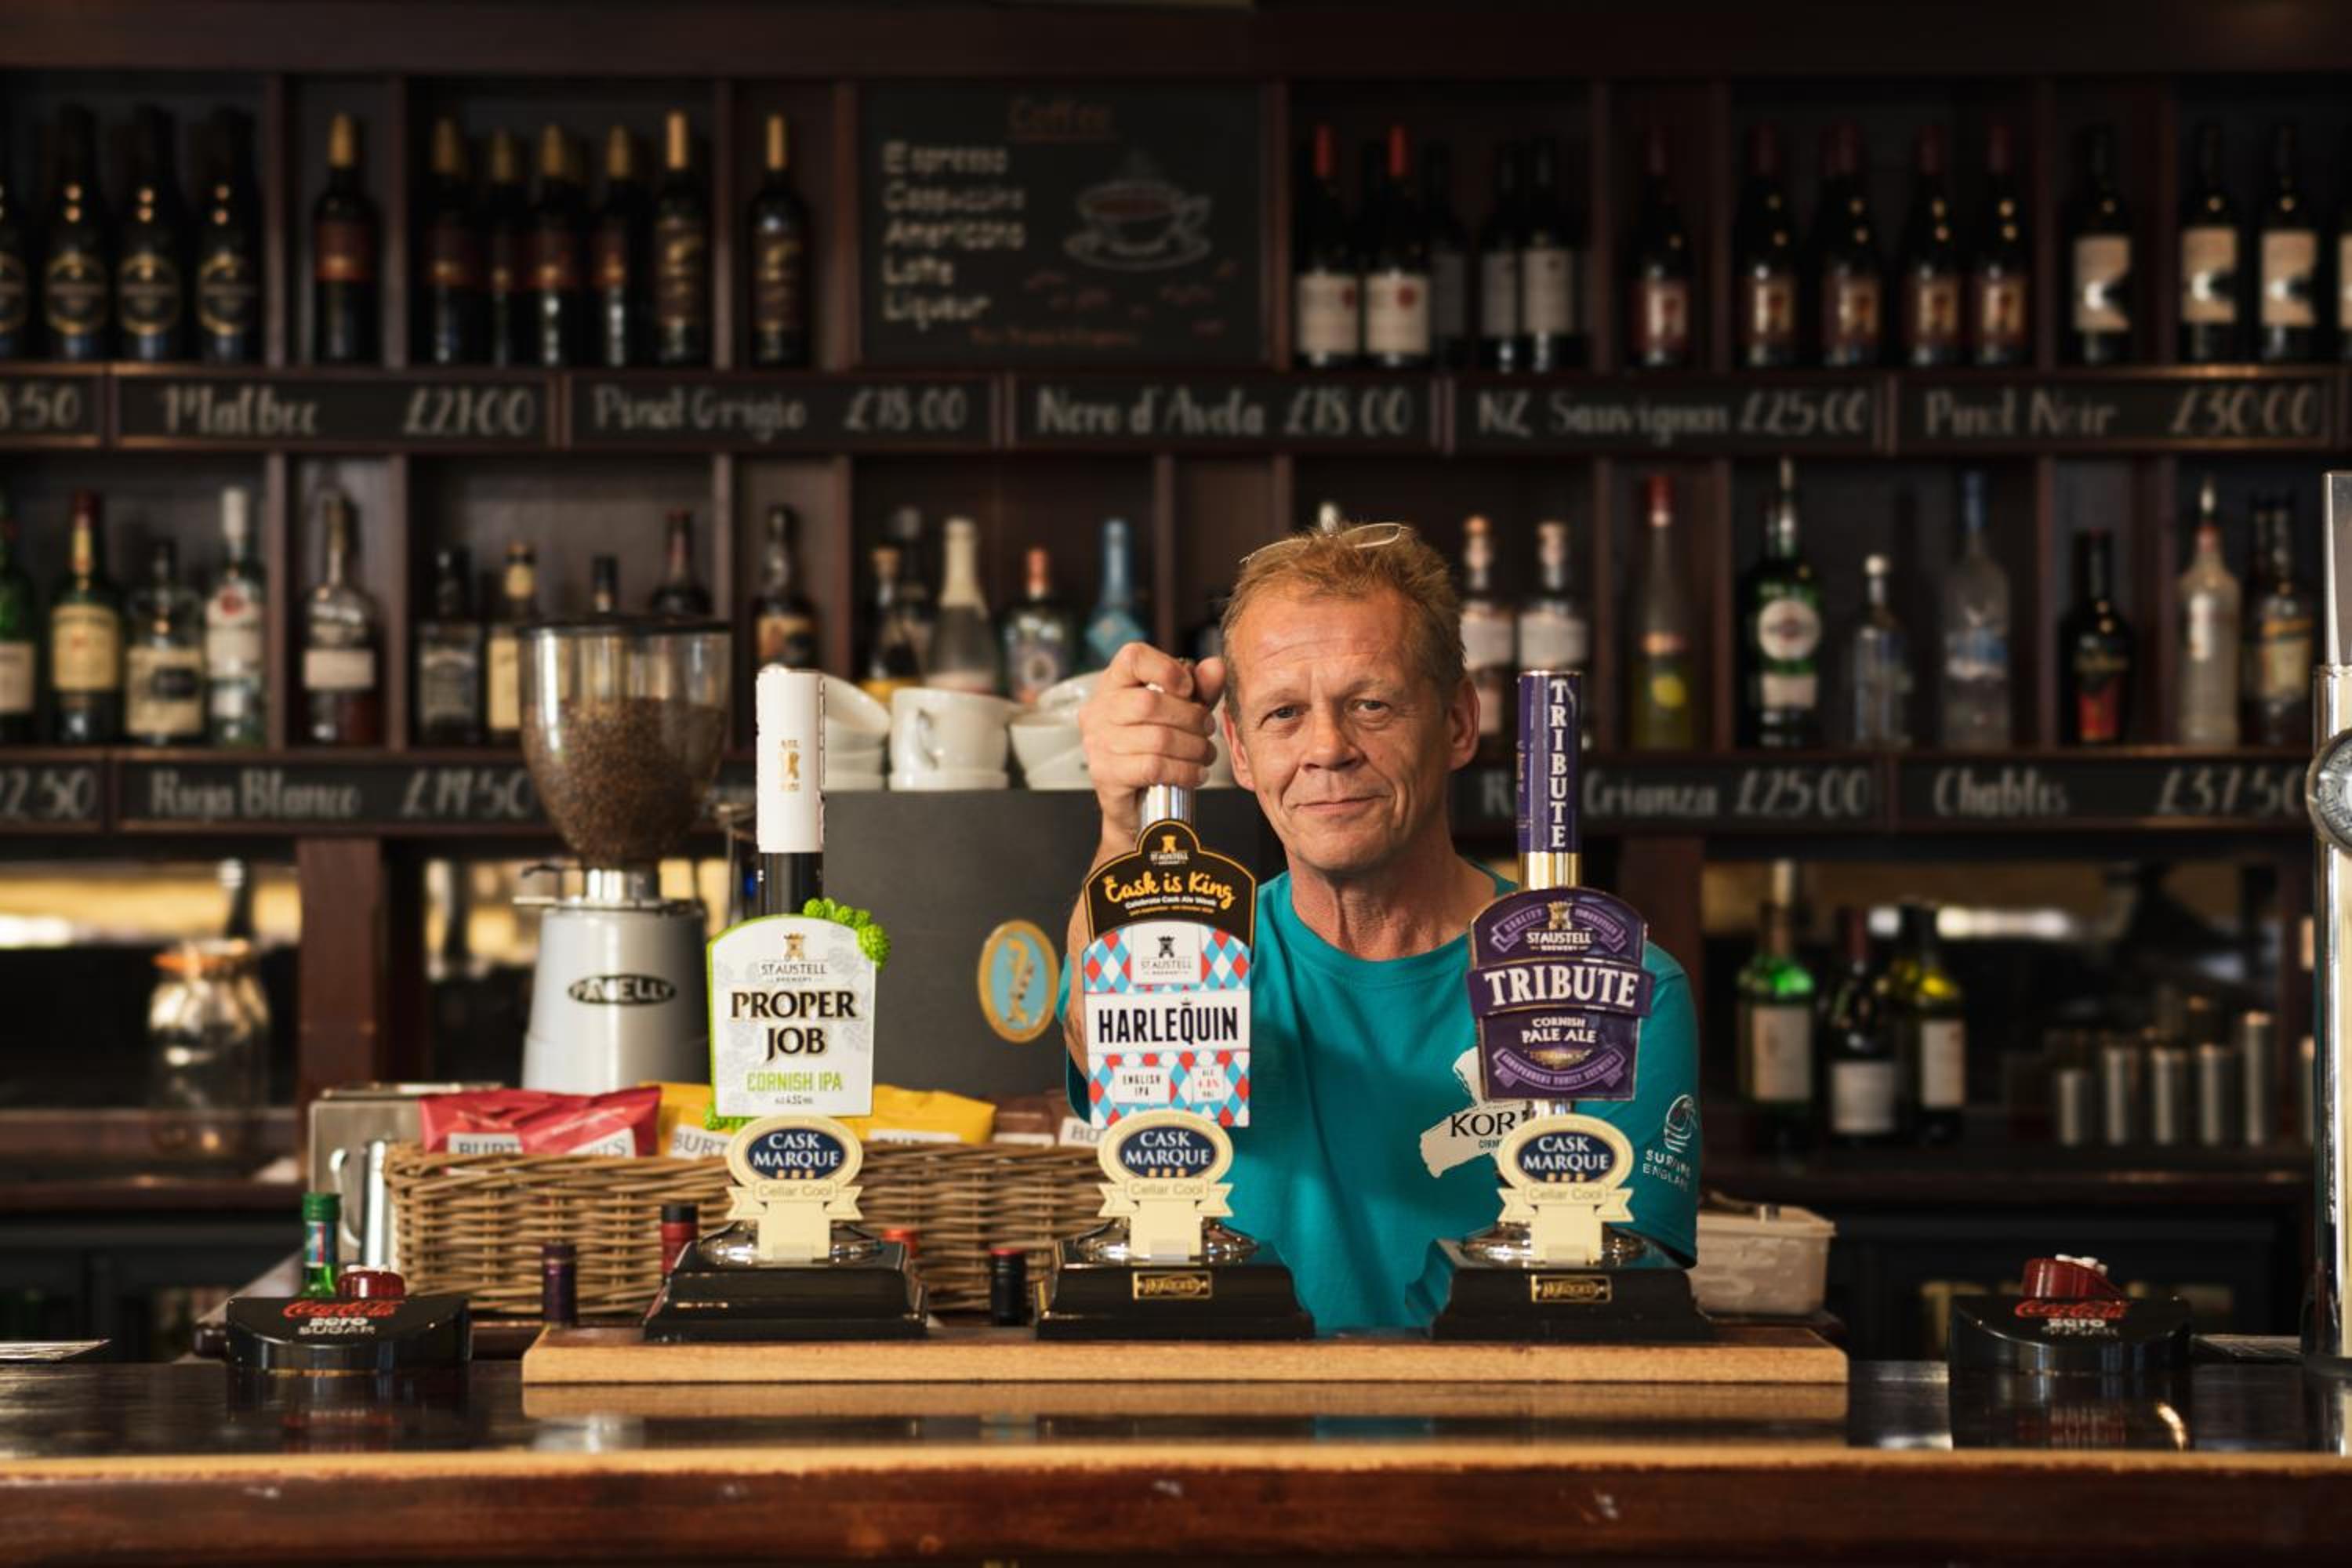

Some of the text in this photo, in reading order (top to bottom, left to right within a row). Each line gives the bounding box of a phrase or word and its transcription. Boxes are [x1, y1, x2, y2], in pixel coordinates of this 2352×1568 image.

[1477, 390, 1533, 439] NZ
[1548, 388, 1730, 448] Sauvignon
[1549, 677, 1568, 848] TRIBUTE
[1933, 766, 2070, 818] Chablis
[1104, 871, 1236, 909] Cask is King
[1540, 932, 1592, 945] AUSTELL
[776, 964, 828, 975] AUSTELL
[1484, 965, 1639, 1007] TRIBUTE
[731, 991, 856, 1018] PROPER
[1098, 1006, 1238, 1045] HARLEQUIN
[1532, 1018, 1586, 1028] CORNISH
[766, 1027, 826, 1061] JOB
[1521, 1029, 1597, 1044] PALE ALE
[747, 1073, 843, 1092] CORNISH IPA
[1123, 1075, 1161, 1085] ENGLISH
[1134, 1087, 1149, 1097] IPA
[1451, 1110, 1516, 1137] KOR
[768, 1133, 820, 1149] CASK
[1140, 1131, 1191, 1147] CASK
[1537, 1136, 1590, 1152] CASK
[753, 1150, 840, 1168] MARQUE
[1125, 1149, 1210, 1167] MARQUE
[1523, 1153, 1610, 1172] MARQUE
[758, 1184, 830, 1196] Cellar Cool
[1131, 1184, 1205, 1196] Cellar Cool
[1530, 1187, 1602, 1200] Cellar Cool
[283, 1301, 397, 1318] Coca-Cola
[2015, 1300, 2123, 1319] Coca-Cola
